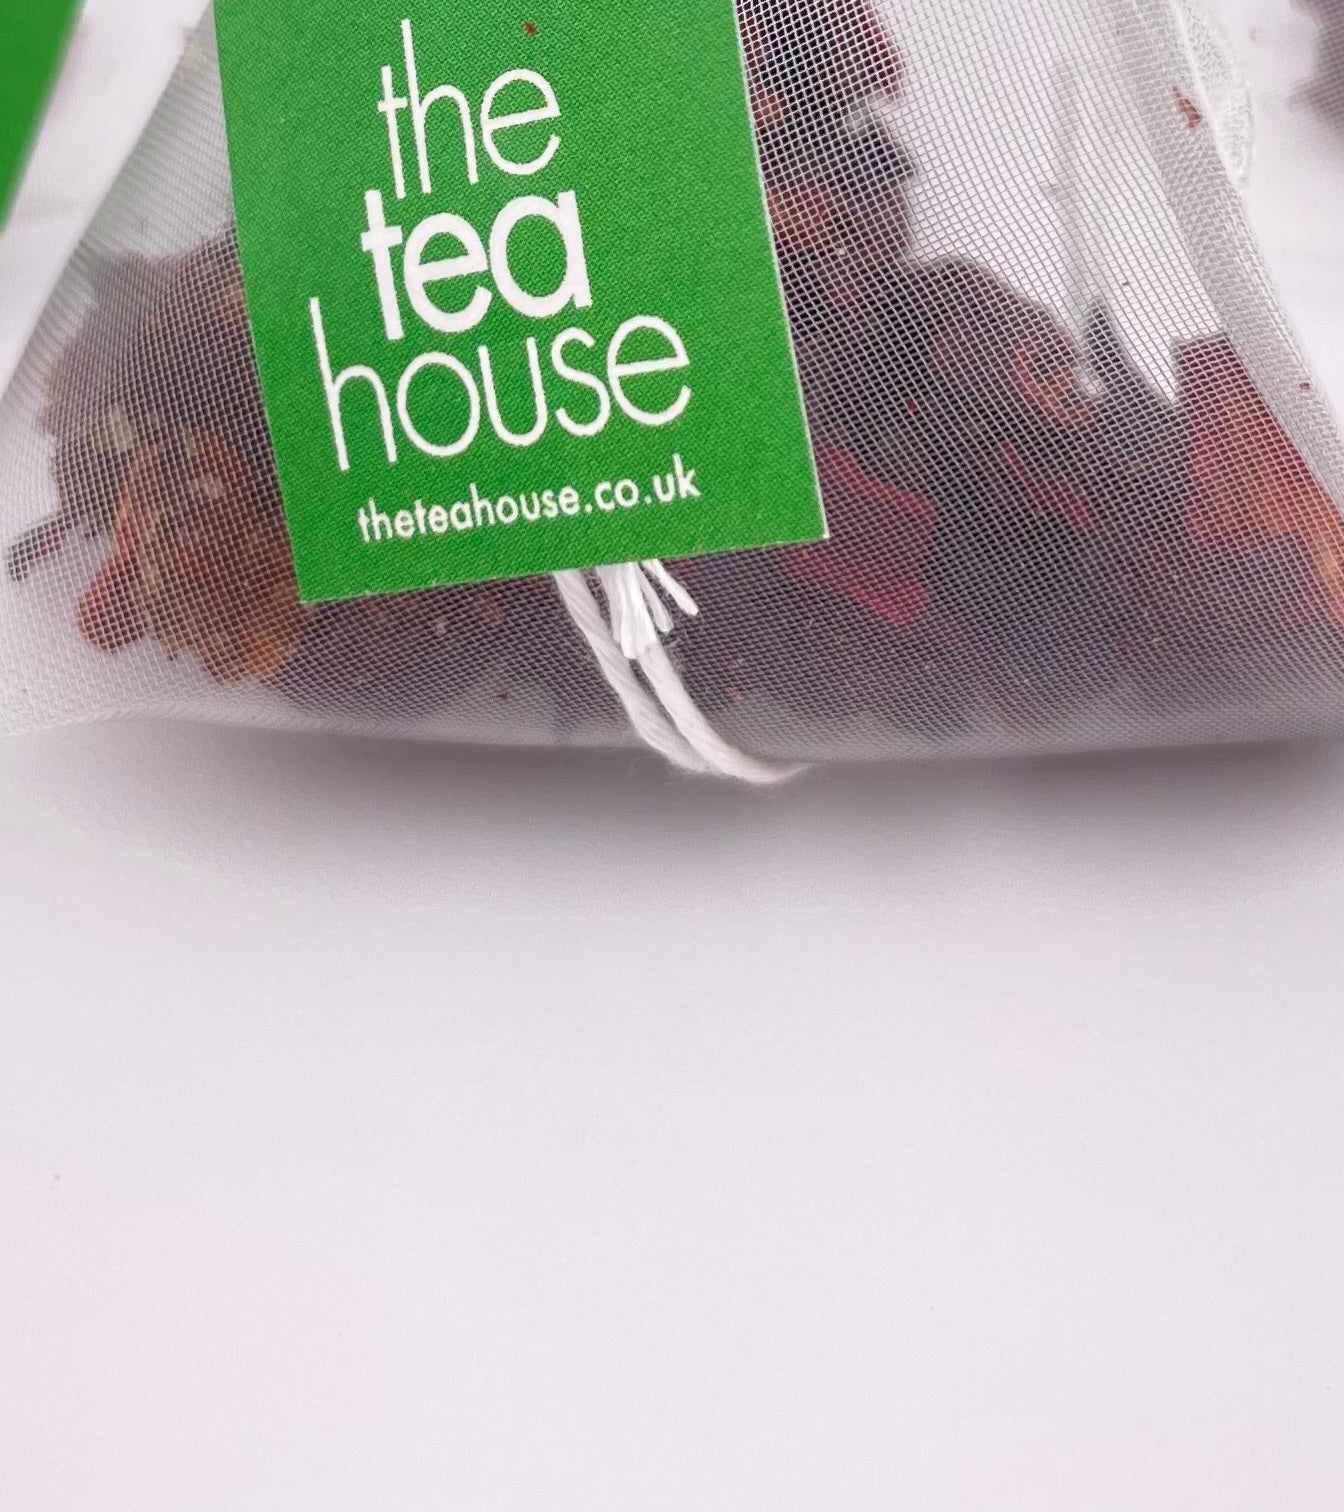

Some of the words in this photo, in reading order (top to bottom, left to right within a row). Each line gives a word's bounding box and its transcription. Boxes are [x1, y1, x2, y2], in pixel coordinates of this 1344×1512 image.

[377, 18, 562, 200] the
[360, 188, 594, 342] tea
[308, 297, 693, 472] house
[357, 452, 702, 544] theteahouse.co.uk
